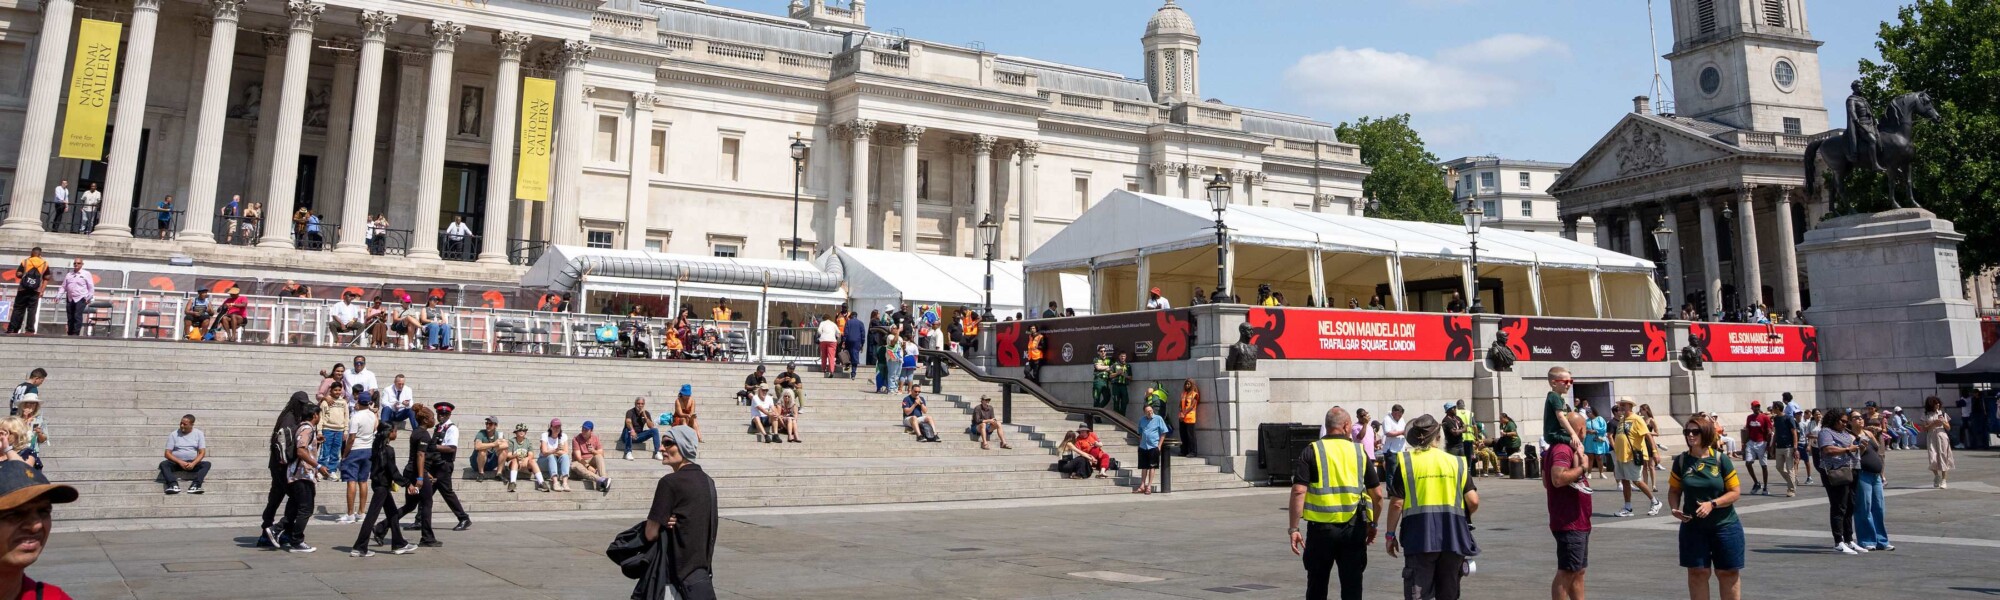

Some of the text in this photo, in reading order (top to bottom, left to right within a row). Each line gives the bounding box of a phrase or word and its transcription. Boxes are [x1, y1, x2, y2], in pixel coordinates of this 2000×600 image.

[79, 42, 99, 106] NATIONAL
[91, 43, 112, 108] GALLERY
[527, 98, 540, 155] NATIONAL
[536, 99, 550, 156] GALLERY
[1318, 320, 1416, 338] NELSON MANDELA DAY
[1729, 332, 1750, 344] NELSON
[1750, 332, 1774, 344] MANDE
[1319, 338, 1360, 350] TRAFALGAR
[1390, 340, 1416, 351] LONDON
[1533, 345, 1552, 354] Nando's
[1730, 345, 1753, 355] TRAFALGAR
[1770, 346, 1785, 355] LONDON
